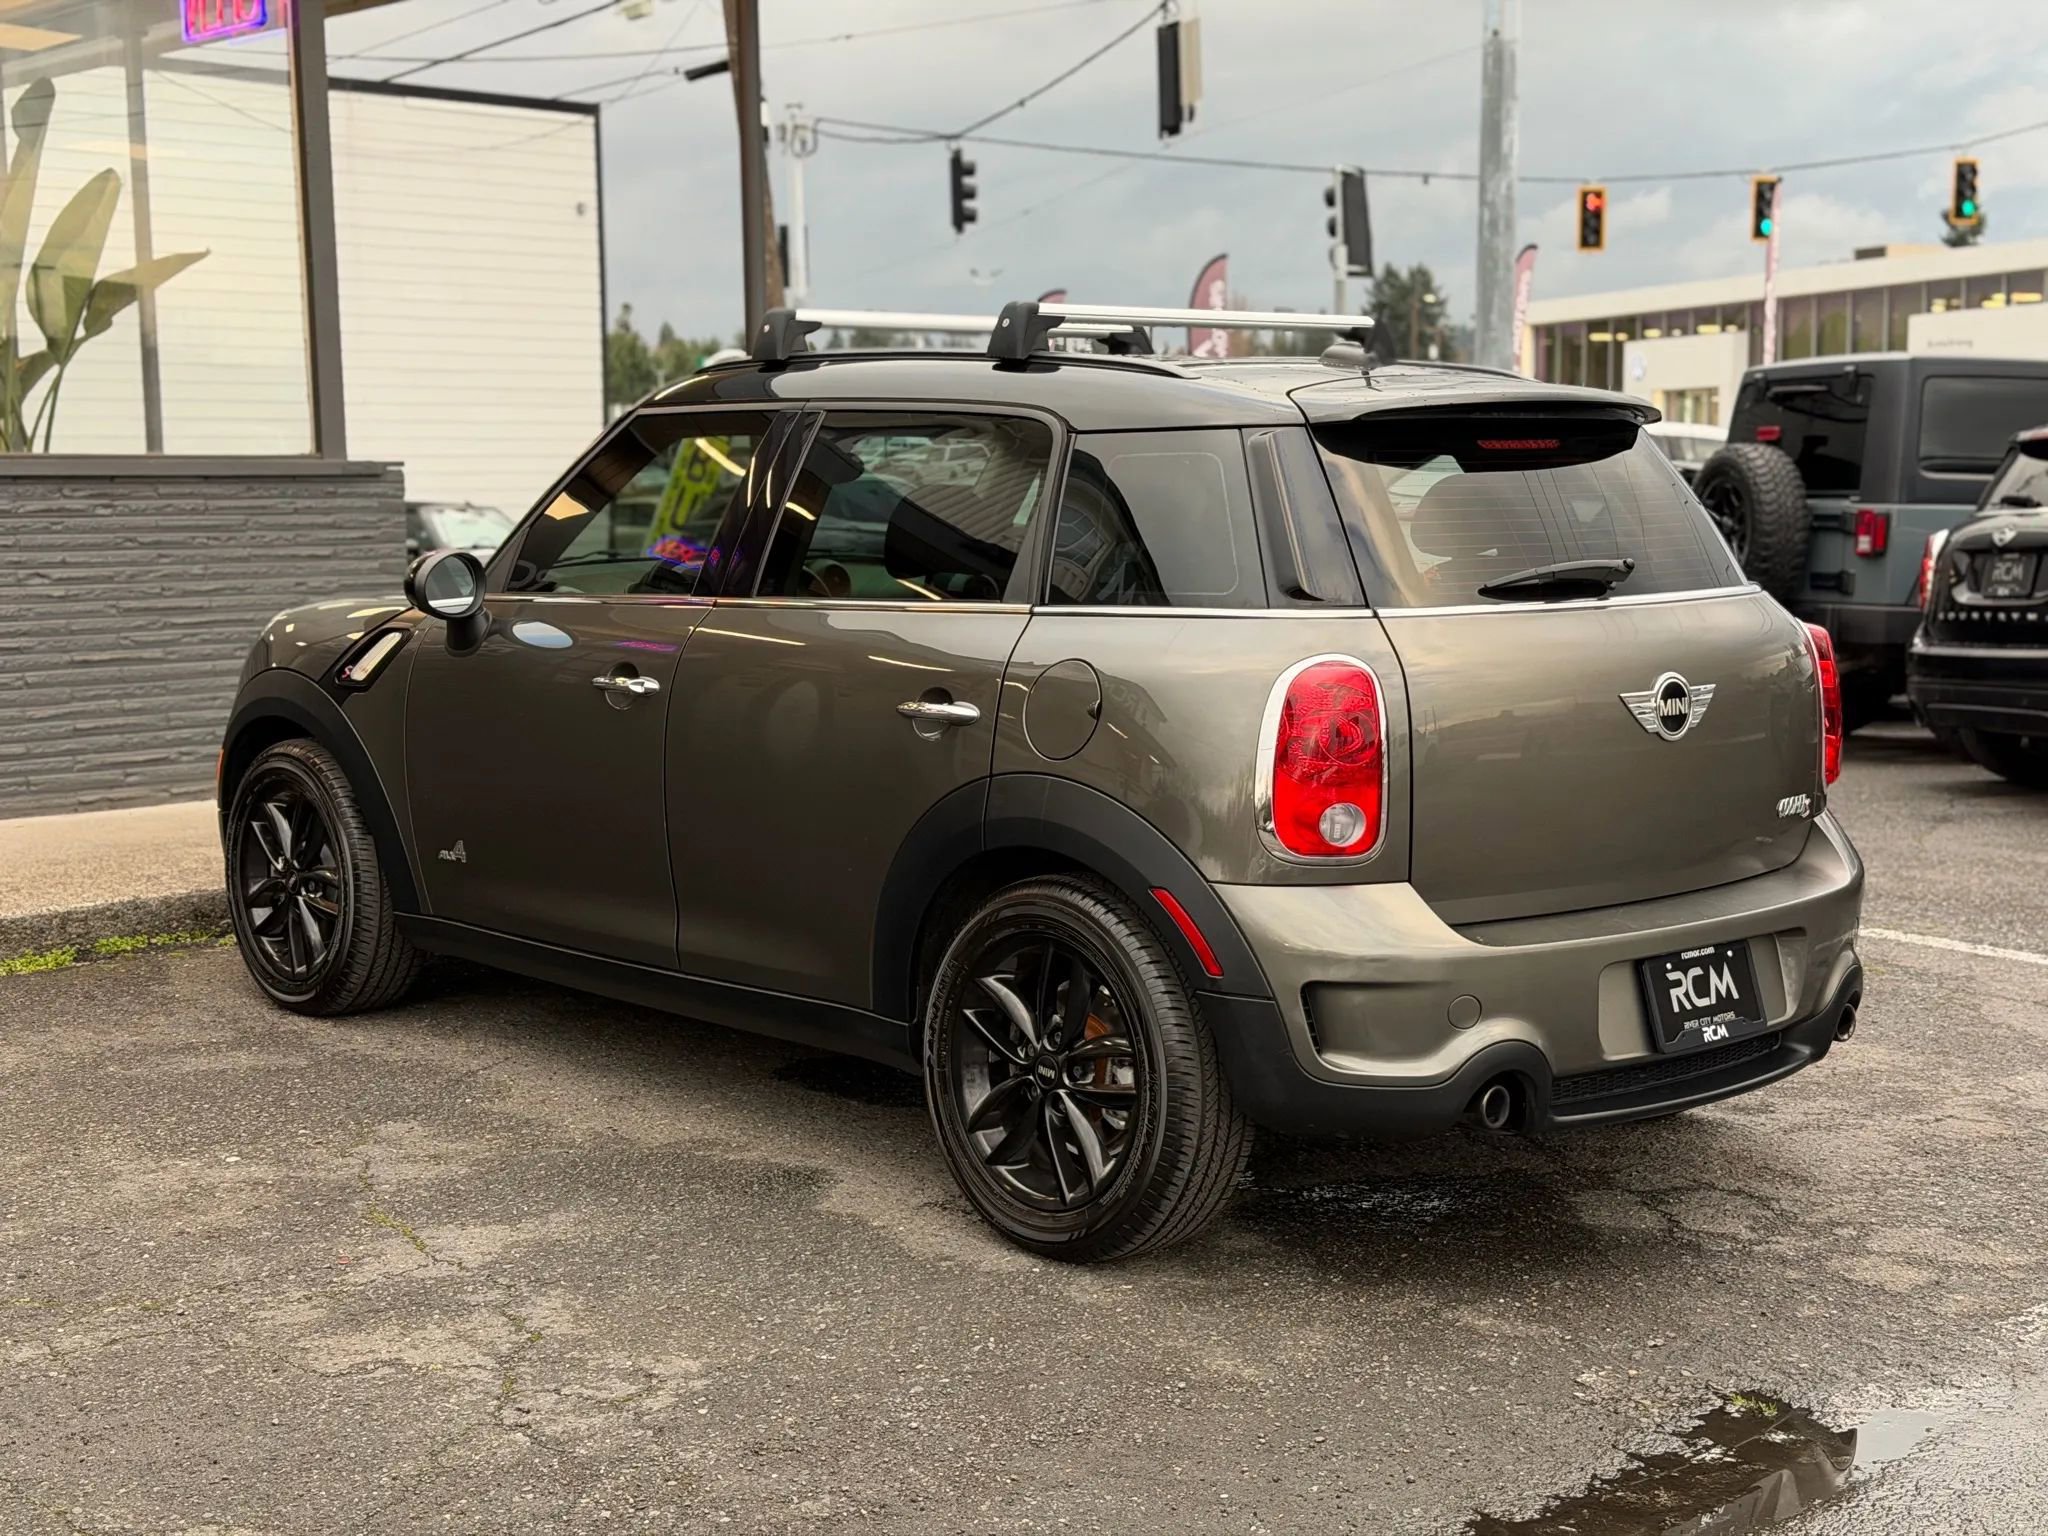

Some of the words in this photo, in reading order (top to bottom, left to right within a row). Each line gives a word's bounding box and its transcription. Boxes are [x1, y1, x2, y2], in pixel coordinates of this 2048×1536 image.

[1660, 697, 1688, 716] MINI
[1666, 961, 1740, 1013] RCM
[1702, 1024, 1729, 1043] RCM
